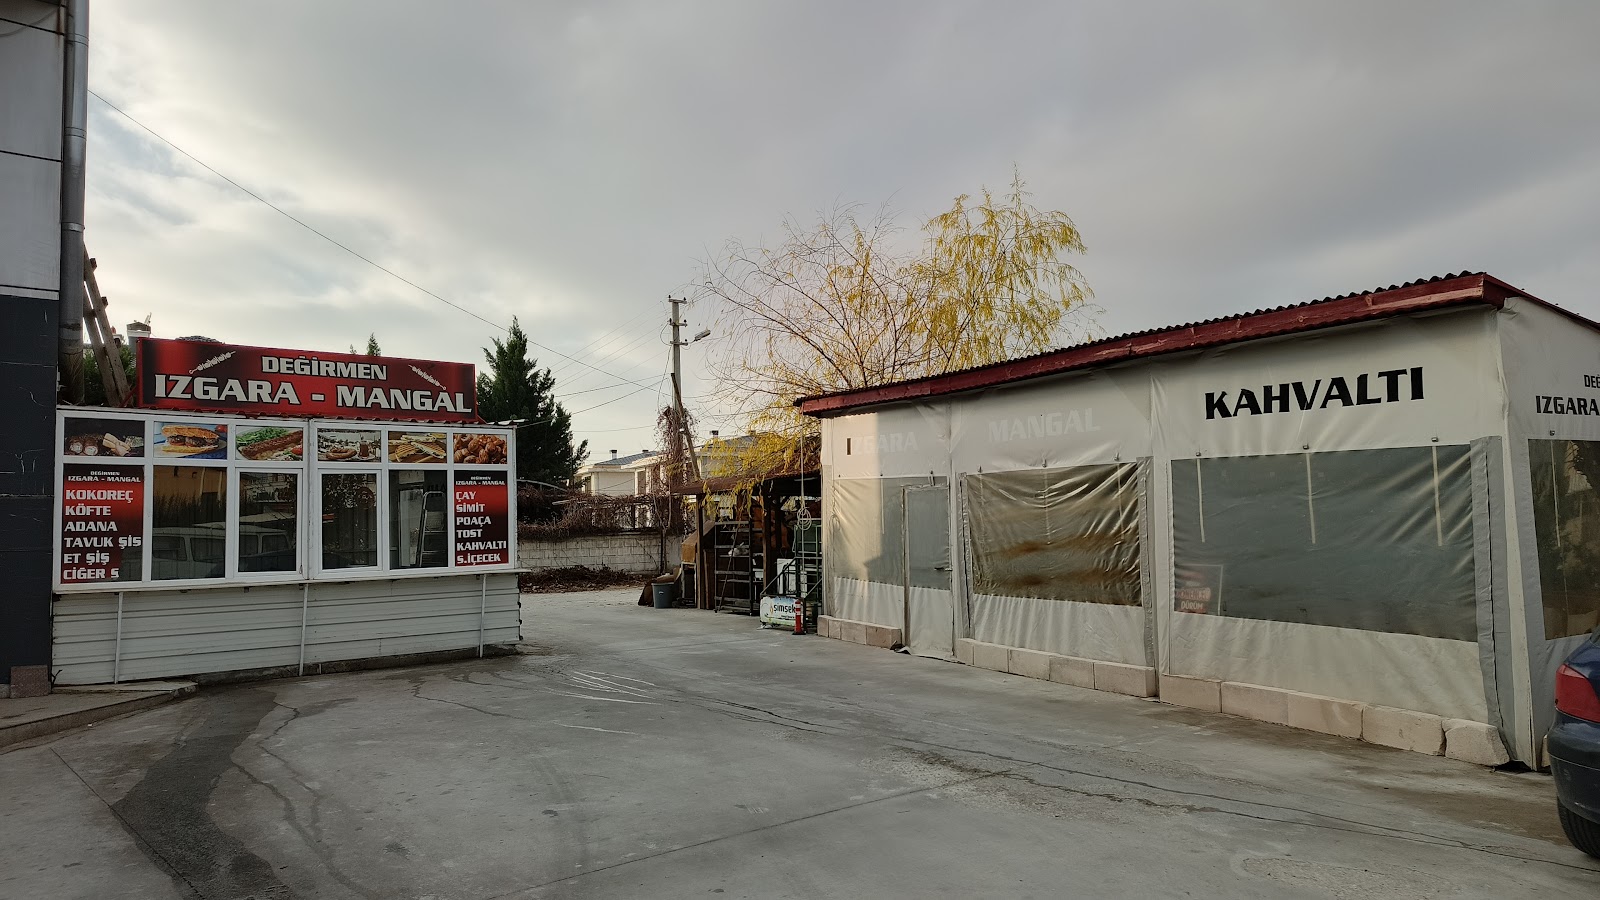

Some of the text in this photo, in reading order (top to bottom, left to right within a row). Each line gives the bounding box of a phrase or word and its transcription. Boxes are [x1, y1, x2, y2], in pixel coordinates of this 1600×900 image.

[261, 355, 388, 381] DEĞİRMEN
[154, 374, 473, 413] IZGARA - MANGAL
[1204, 366, 1425, 420] KAHVALTI
[1535, 395, 1600, 416] IZGARA
[988, 407, 1101, 443] MANGAL
[65, 489, 134, 504] KOKOREÇ
[455, 491, 476, 503] ÇAY
[65, 503, 112, 516] KÖFTE
[455, 502, 486, 513] SİMİT
[64, 521, 118, 532] ADANA
[456, 516, 492, 527] POAÇA
[456, 529, 483, 539] TOST
[63, 536, 114, 548] TAVUK
[456, 540, 507, 551] KAHVALTI
[63, 550, 110, 566] ET ŞİŞ
[456, 553, 502, 566] S.İÇECEK
[63, 566, 106, 580] CİĞER
